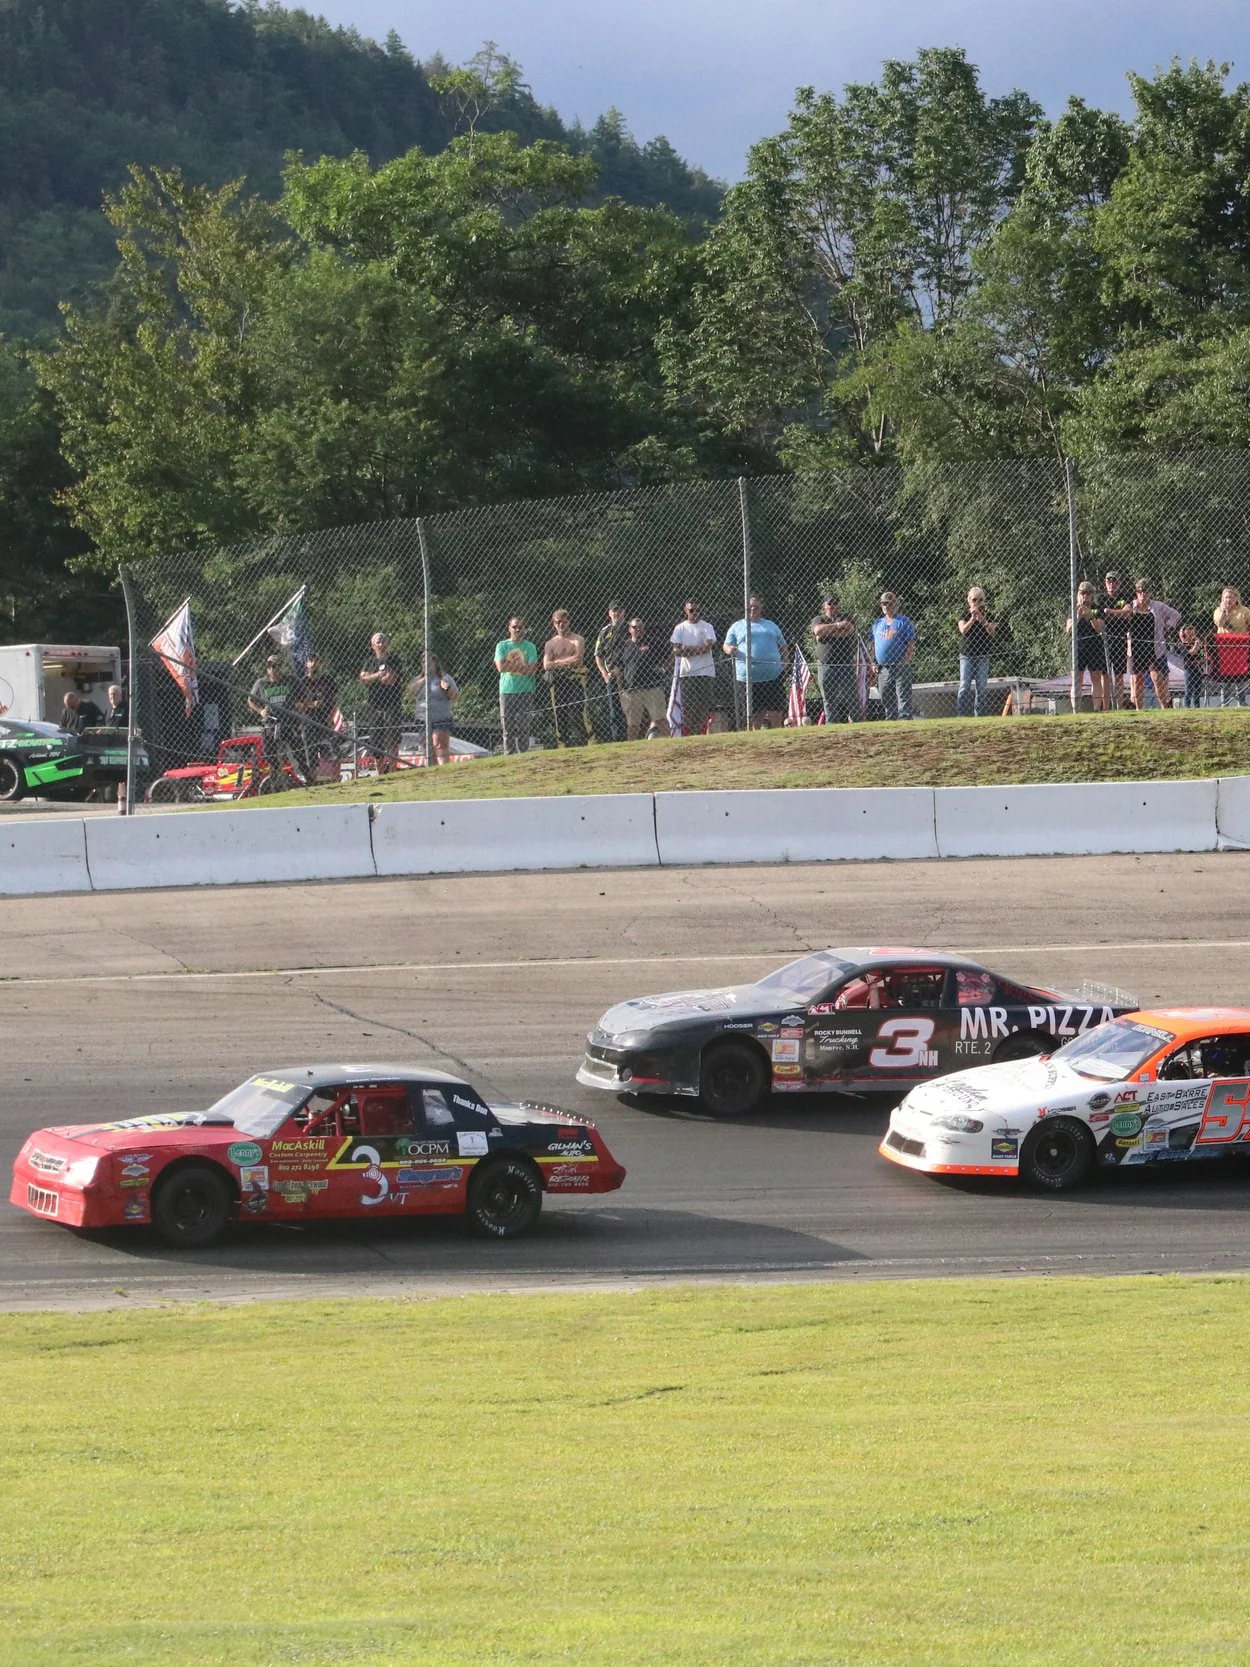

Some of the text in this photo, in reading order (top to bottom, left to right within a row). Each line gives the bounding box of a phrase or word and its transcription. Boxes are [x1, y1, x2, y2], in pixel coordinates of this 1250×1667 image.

[960, 1007, 1018, 1041] MR.
[819, 1035, 859, 1045] Trucking
[869, 1016, 935, 1068] 3
[955, 1041, 991, 1054] RTE. 2
[919, 1050, 939, 1067] NH
[453, 1094, 475, 1111] Thanks
[1113, 1090, 1139, 1104] ACT
[1112, 1119, 1141, 1130] Lenny's
[272, 1139, 325, 1151] MacAskill
[408, 1143, 449, 1156] OCPM
[547, 1139, 593, 1150] GILMAN'S
[294, 1151, 328, 1159] Carpentry
[351, 1145, 389, 1206] 3
[505, 1165, 537, 1194] Hoosier
[388, 1192, 409, 1205] VT
